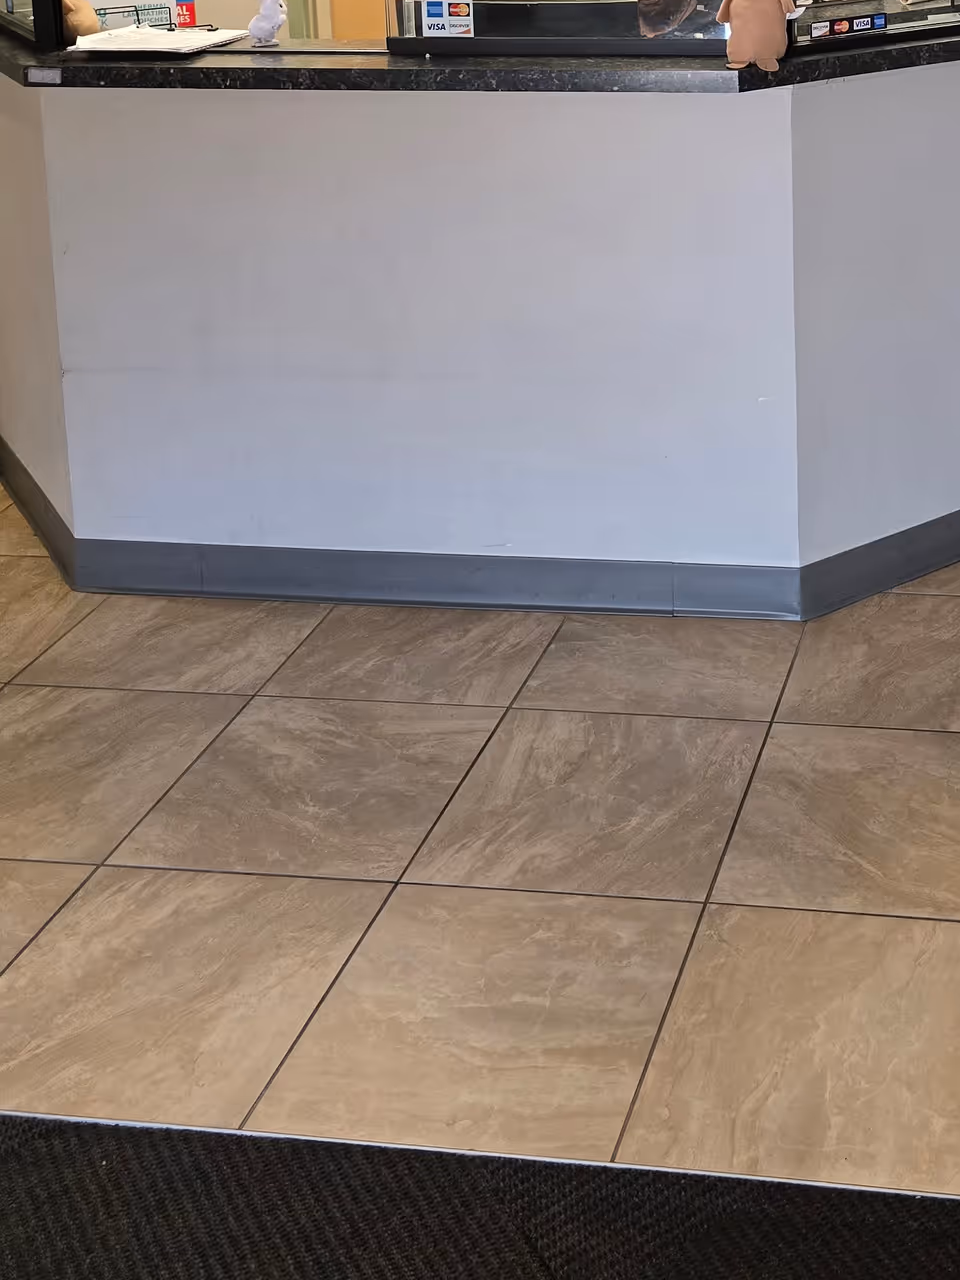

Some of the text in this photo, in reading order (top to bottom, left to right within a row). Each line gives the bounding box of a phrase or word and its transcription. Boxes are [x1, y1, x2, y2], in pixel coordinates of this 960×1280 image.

[122, 10, 169, 18] LAMNATING
[427, 23, 446, 31] VISA
[855, 20, 870, 28] VISA
